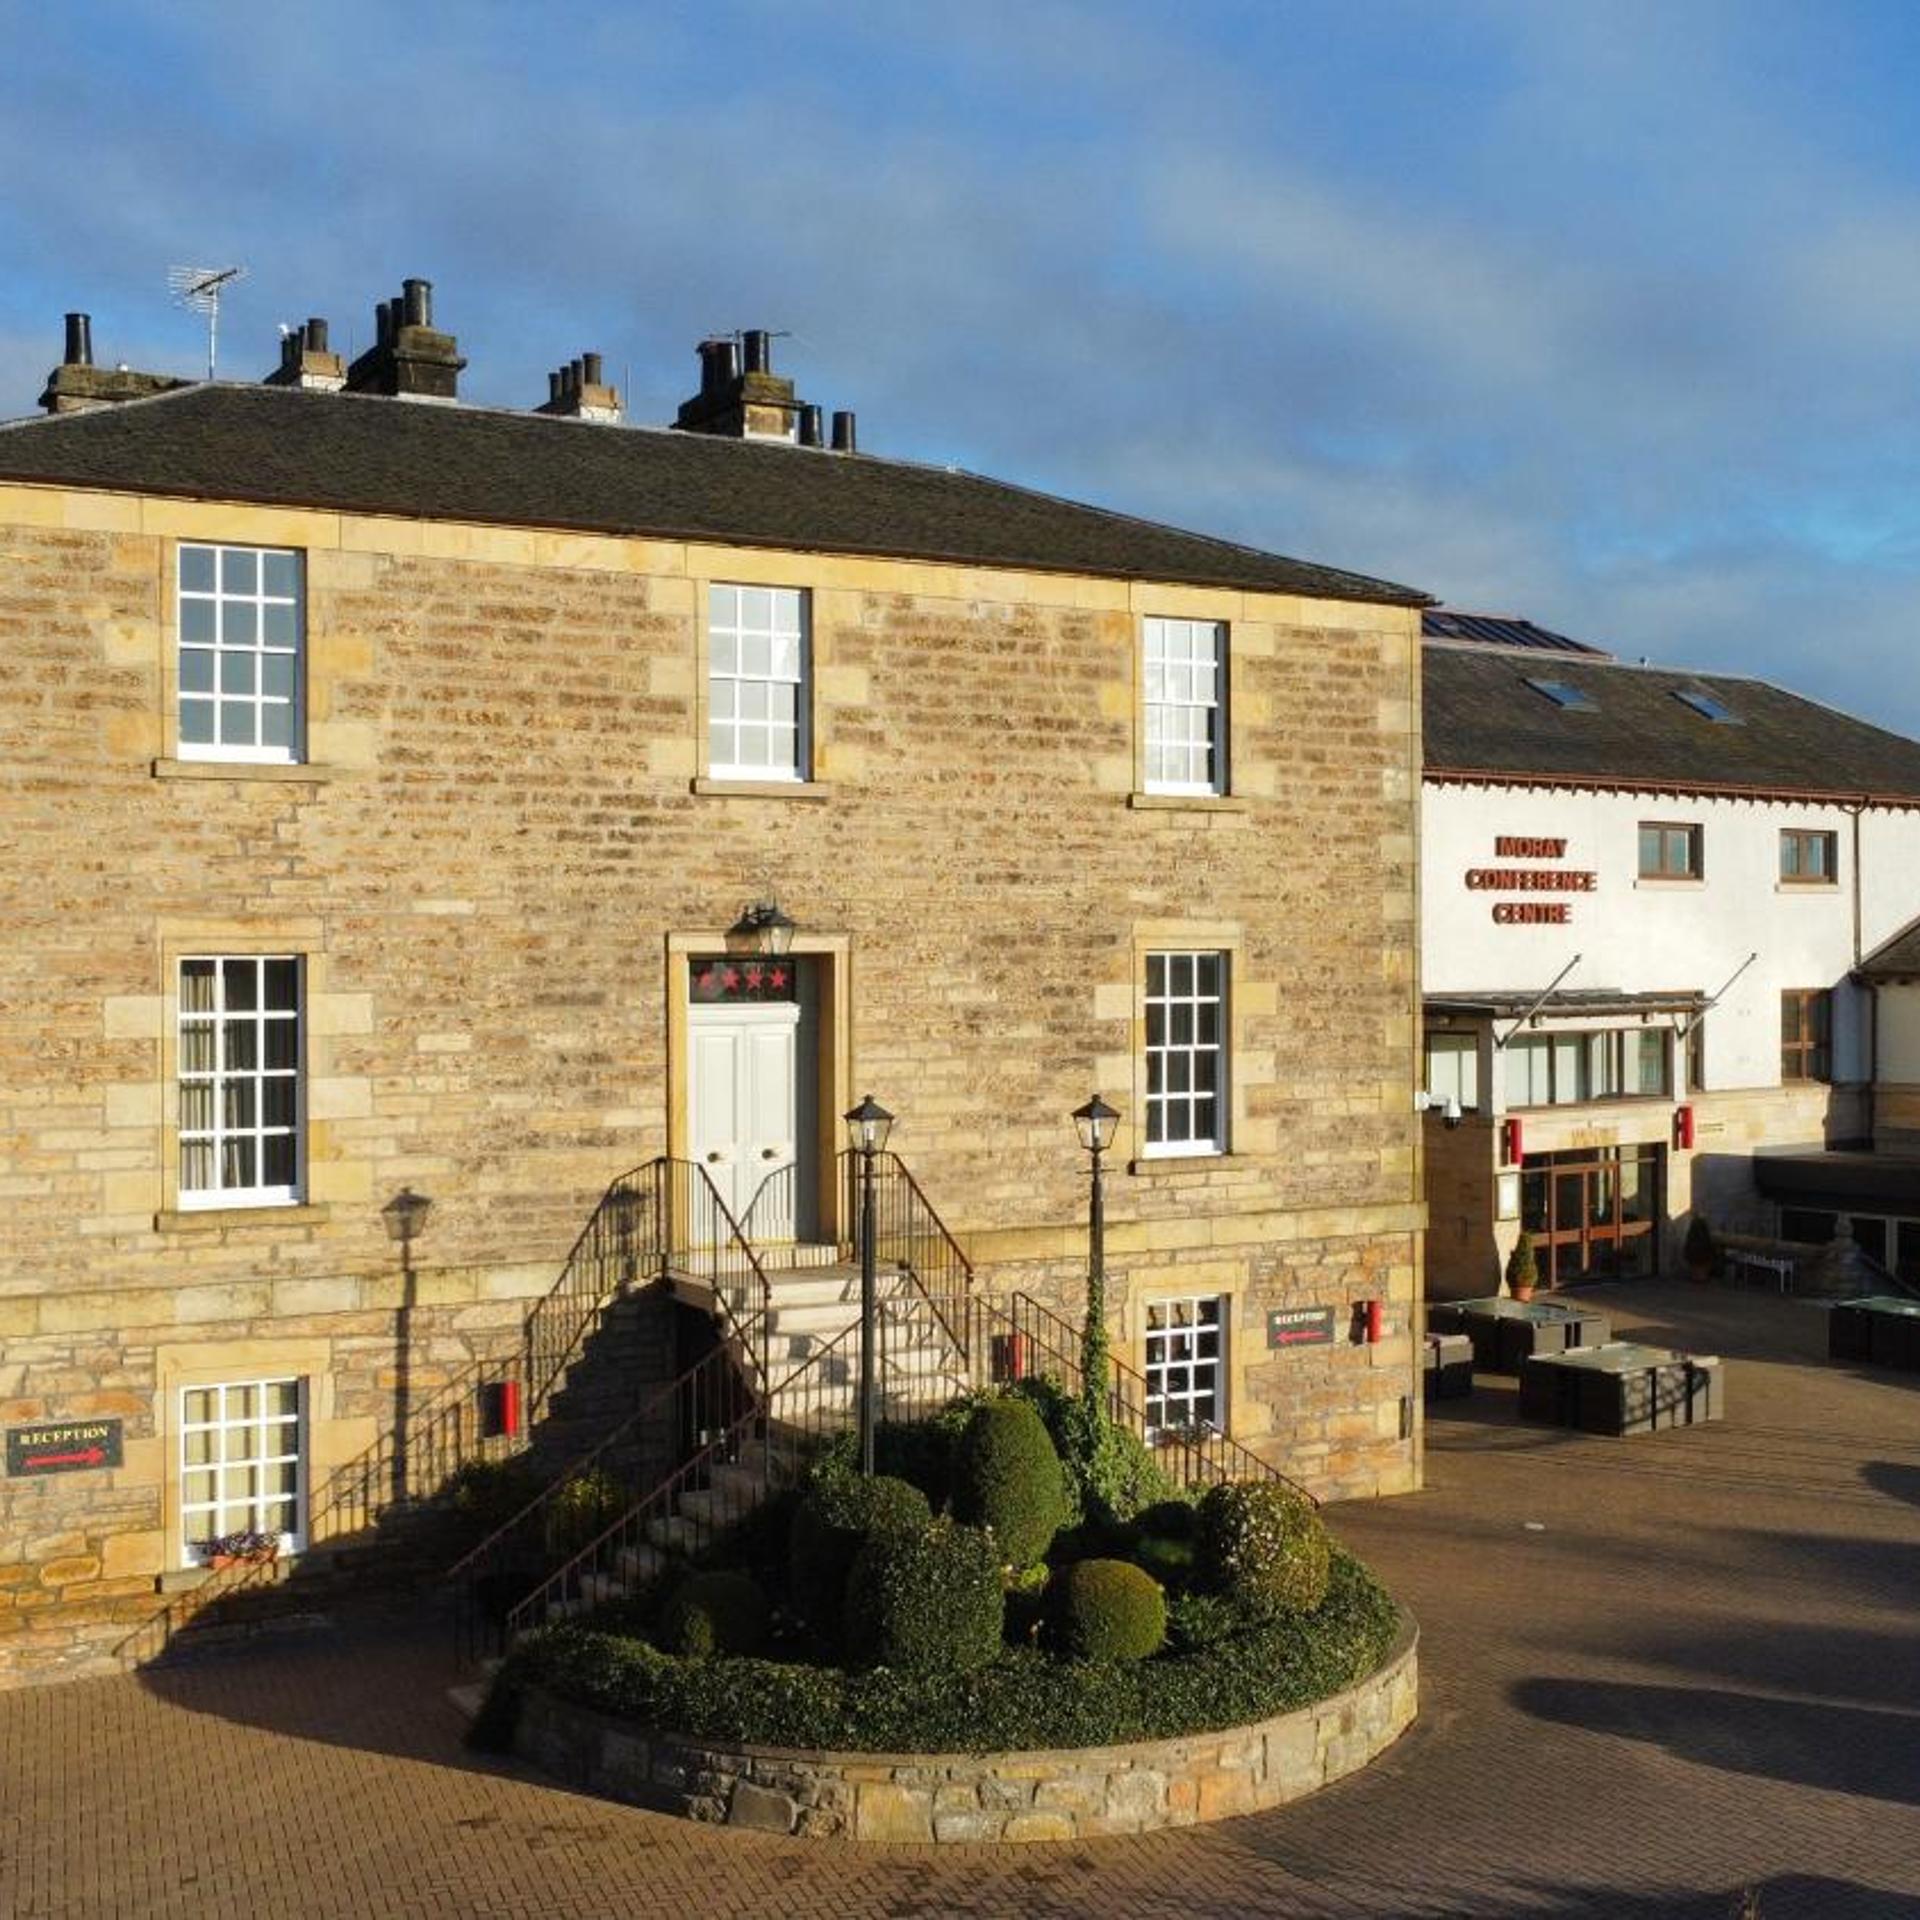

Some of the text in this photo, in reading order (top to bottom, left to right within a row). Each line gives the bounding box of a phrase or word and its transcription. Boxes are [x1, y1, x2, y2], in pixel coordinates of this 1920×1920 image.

[1495, 837, 1567, 858] MORAY
[1465, 869, 1597, 891] CONFERENCE
[1492, 903, 1572, 924] CENTRE
